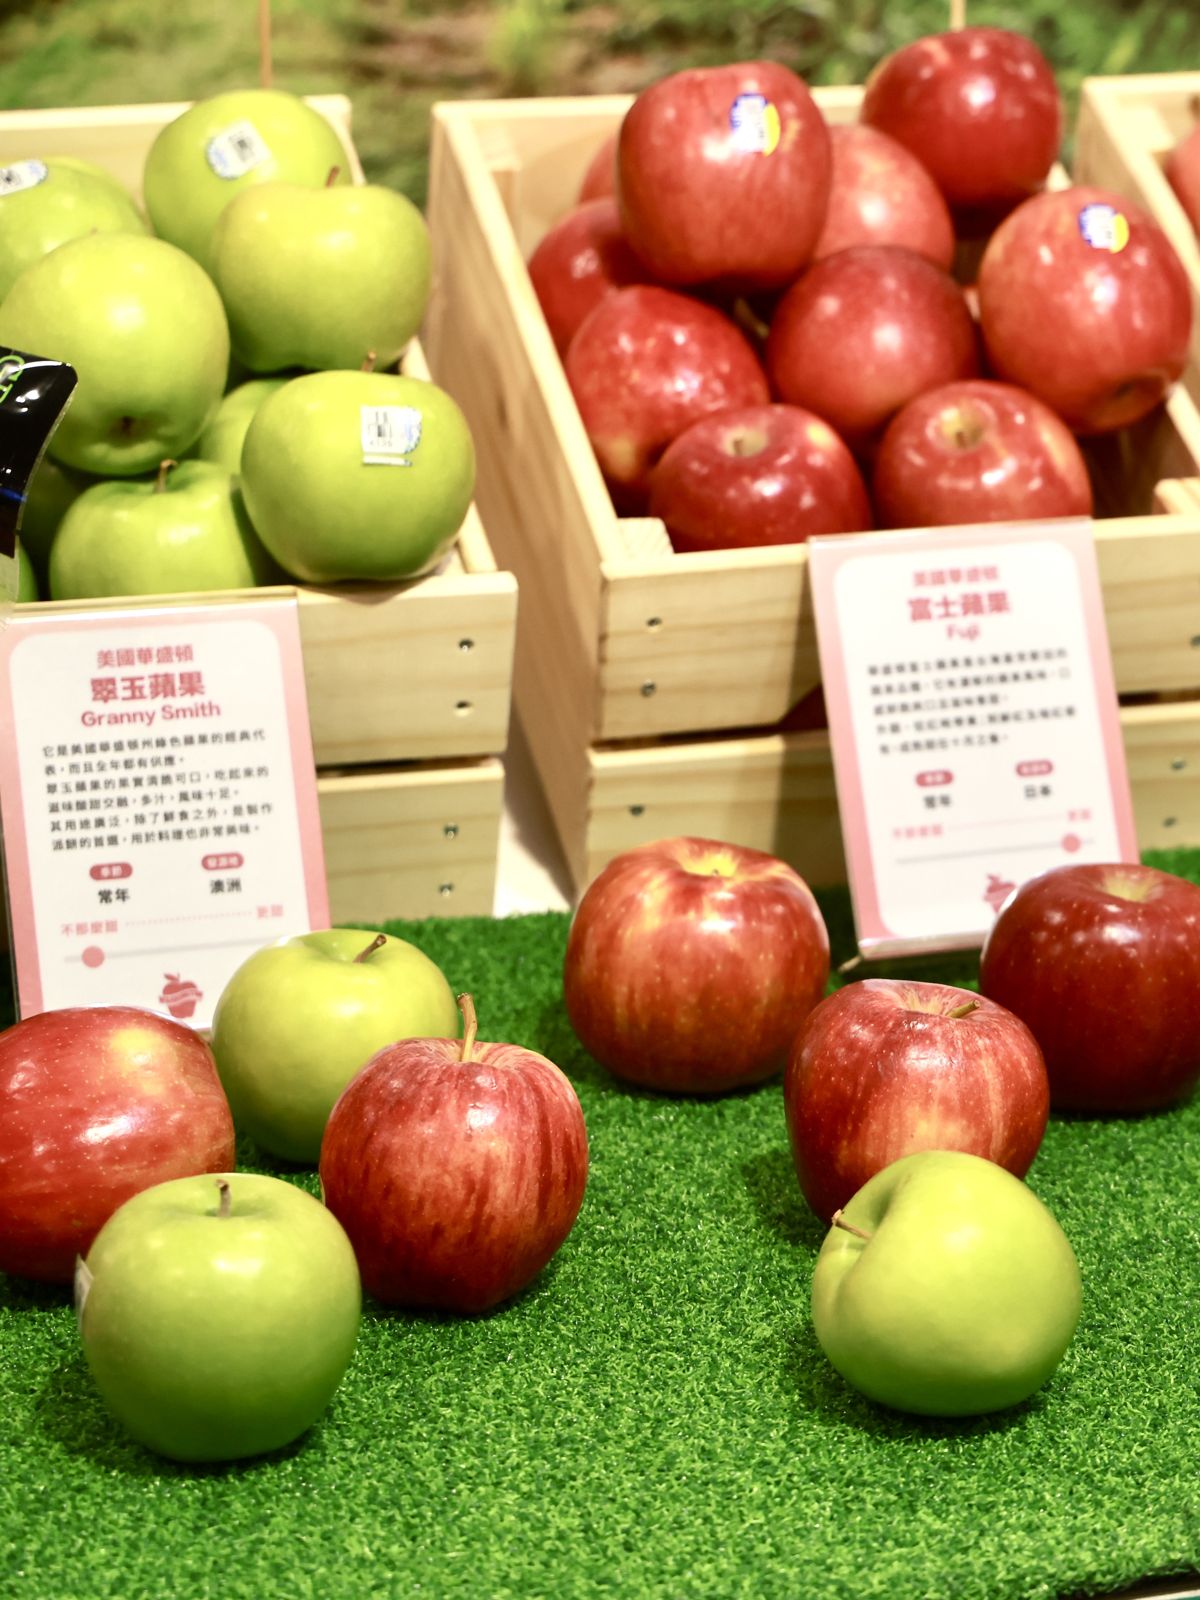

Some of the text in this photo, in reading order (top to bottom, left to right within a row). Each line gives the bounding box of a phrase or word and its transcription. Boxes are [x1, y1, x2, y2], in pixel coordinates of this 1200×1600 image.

[907, 591, 1011, 622] 富士蘋果
[946, 623, 980, 641] Fuji
[97, 644, 194, 669] 美國華盛頓
[90, 671, 206, 703] 翠玉蘋果
[81, 700, 222, 727] Granny Smith
[98, 878, 242, 904] 常年 澳洲
